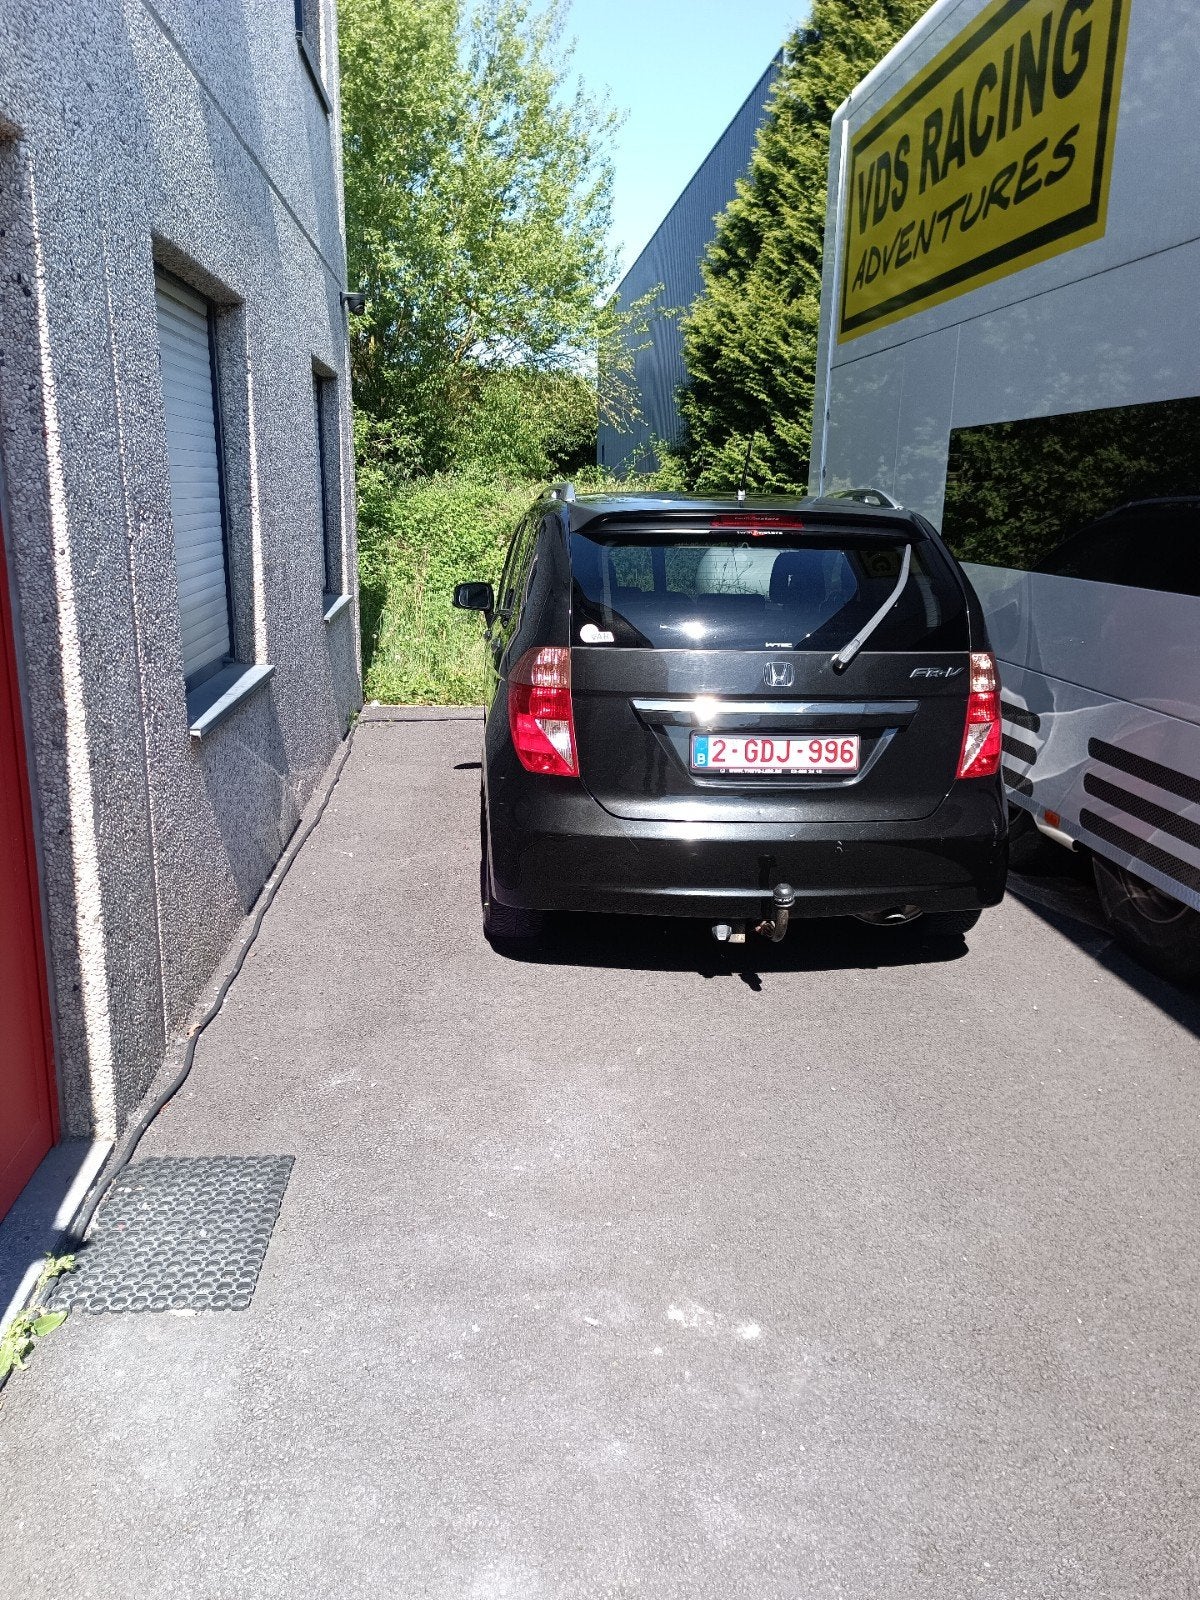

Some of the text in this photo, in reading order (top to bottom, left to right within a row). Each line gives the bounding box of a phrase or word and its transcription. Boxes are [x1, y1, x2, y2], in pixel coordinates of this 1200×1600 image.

[858, 0, 1094, 235] VDS RACING
[852, 123, 1080, 293] ADVENTURES
[697, 739, 855, 765] B 2-GDJ-996
